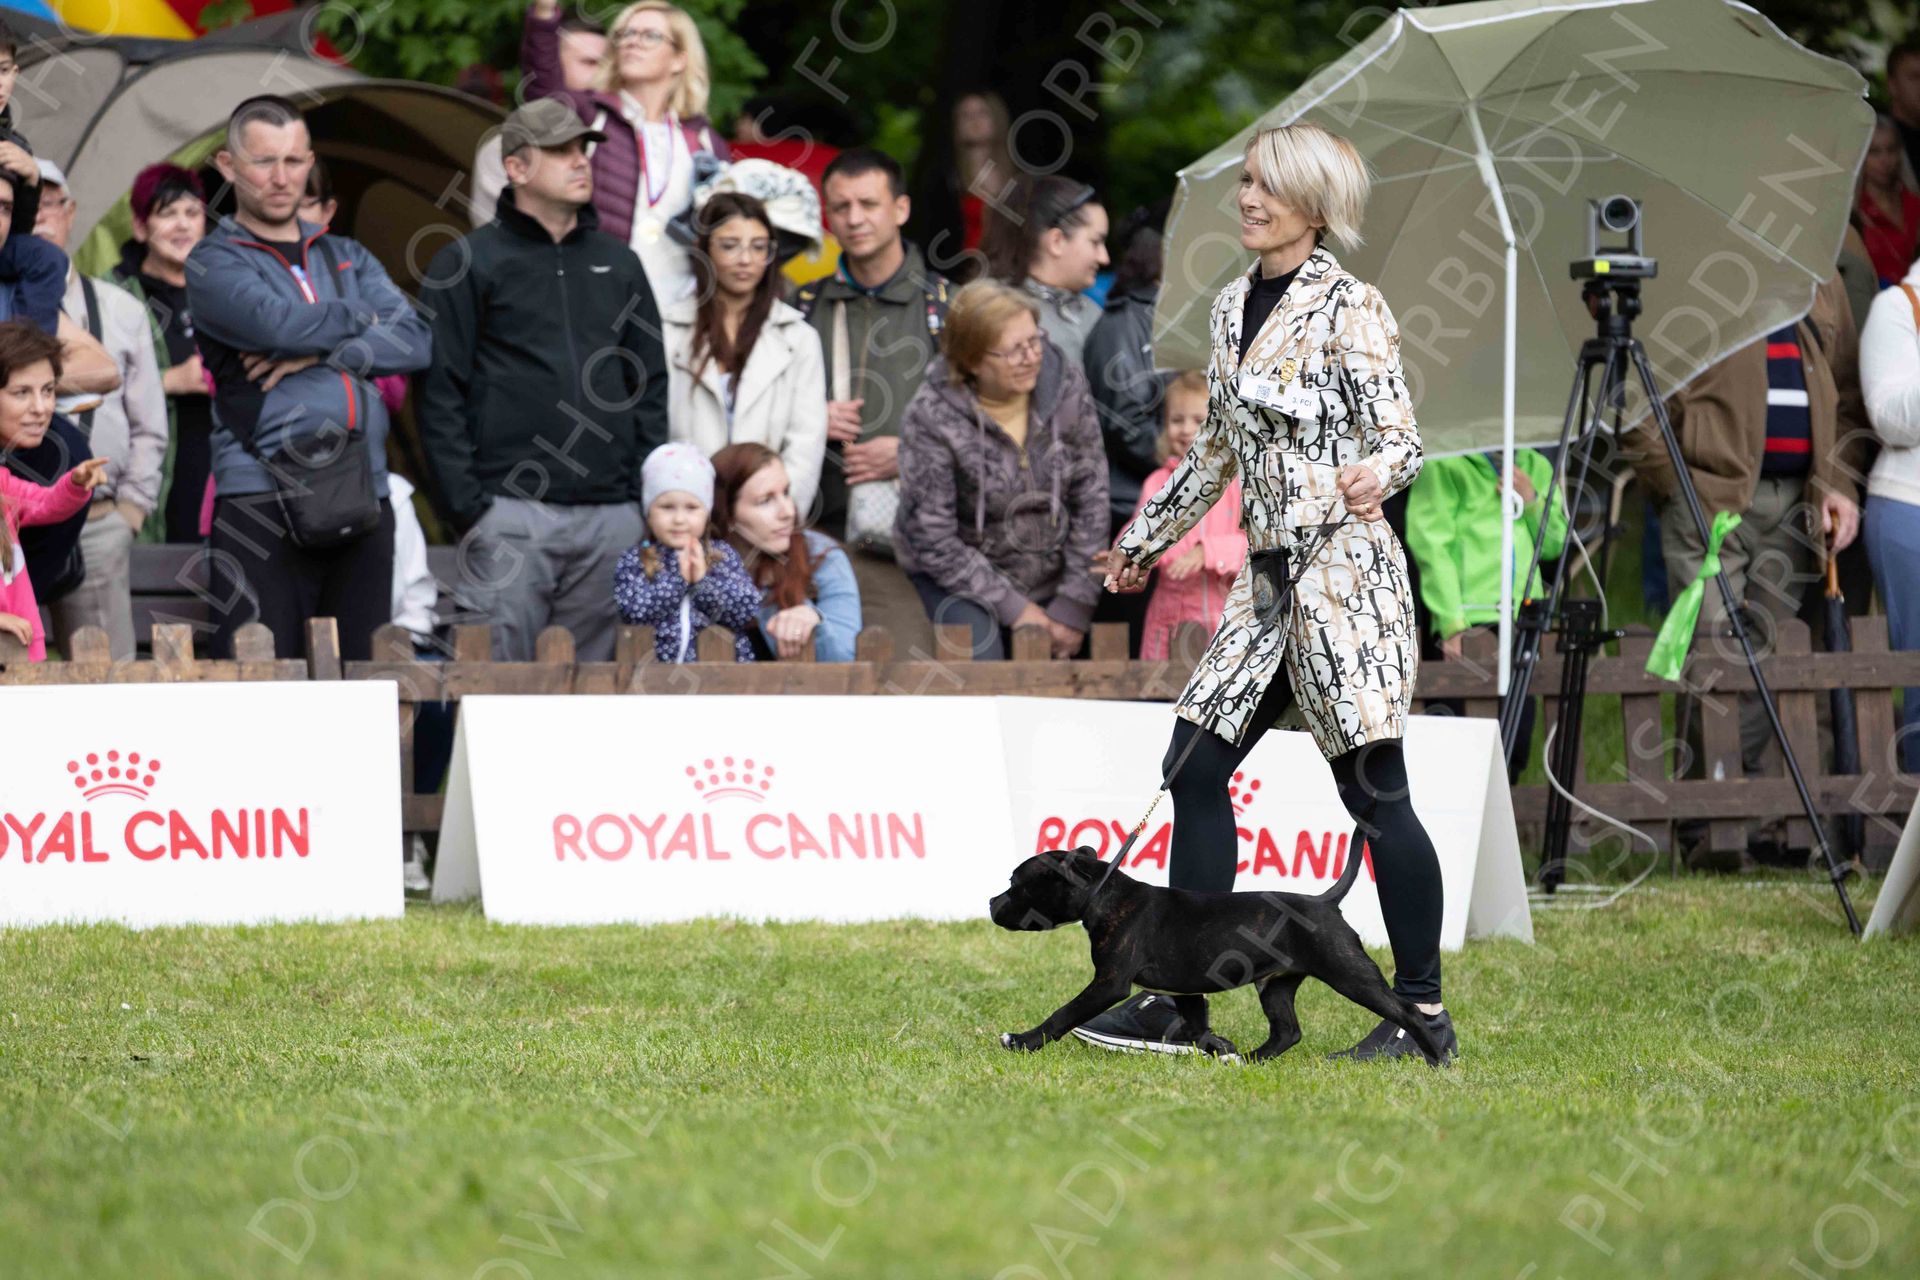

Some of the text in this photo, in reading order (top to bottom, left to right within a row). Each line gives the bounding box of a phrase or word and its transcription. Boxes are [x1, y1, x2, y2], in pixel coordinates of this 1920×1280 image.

[0, 807, 309, 863] YAL CANIN
[553, 812, 926, 862] ROYAL CANIN
[1035, 816, 1172, 870] ROYA
